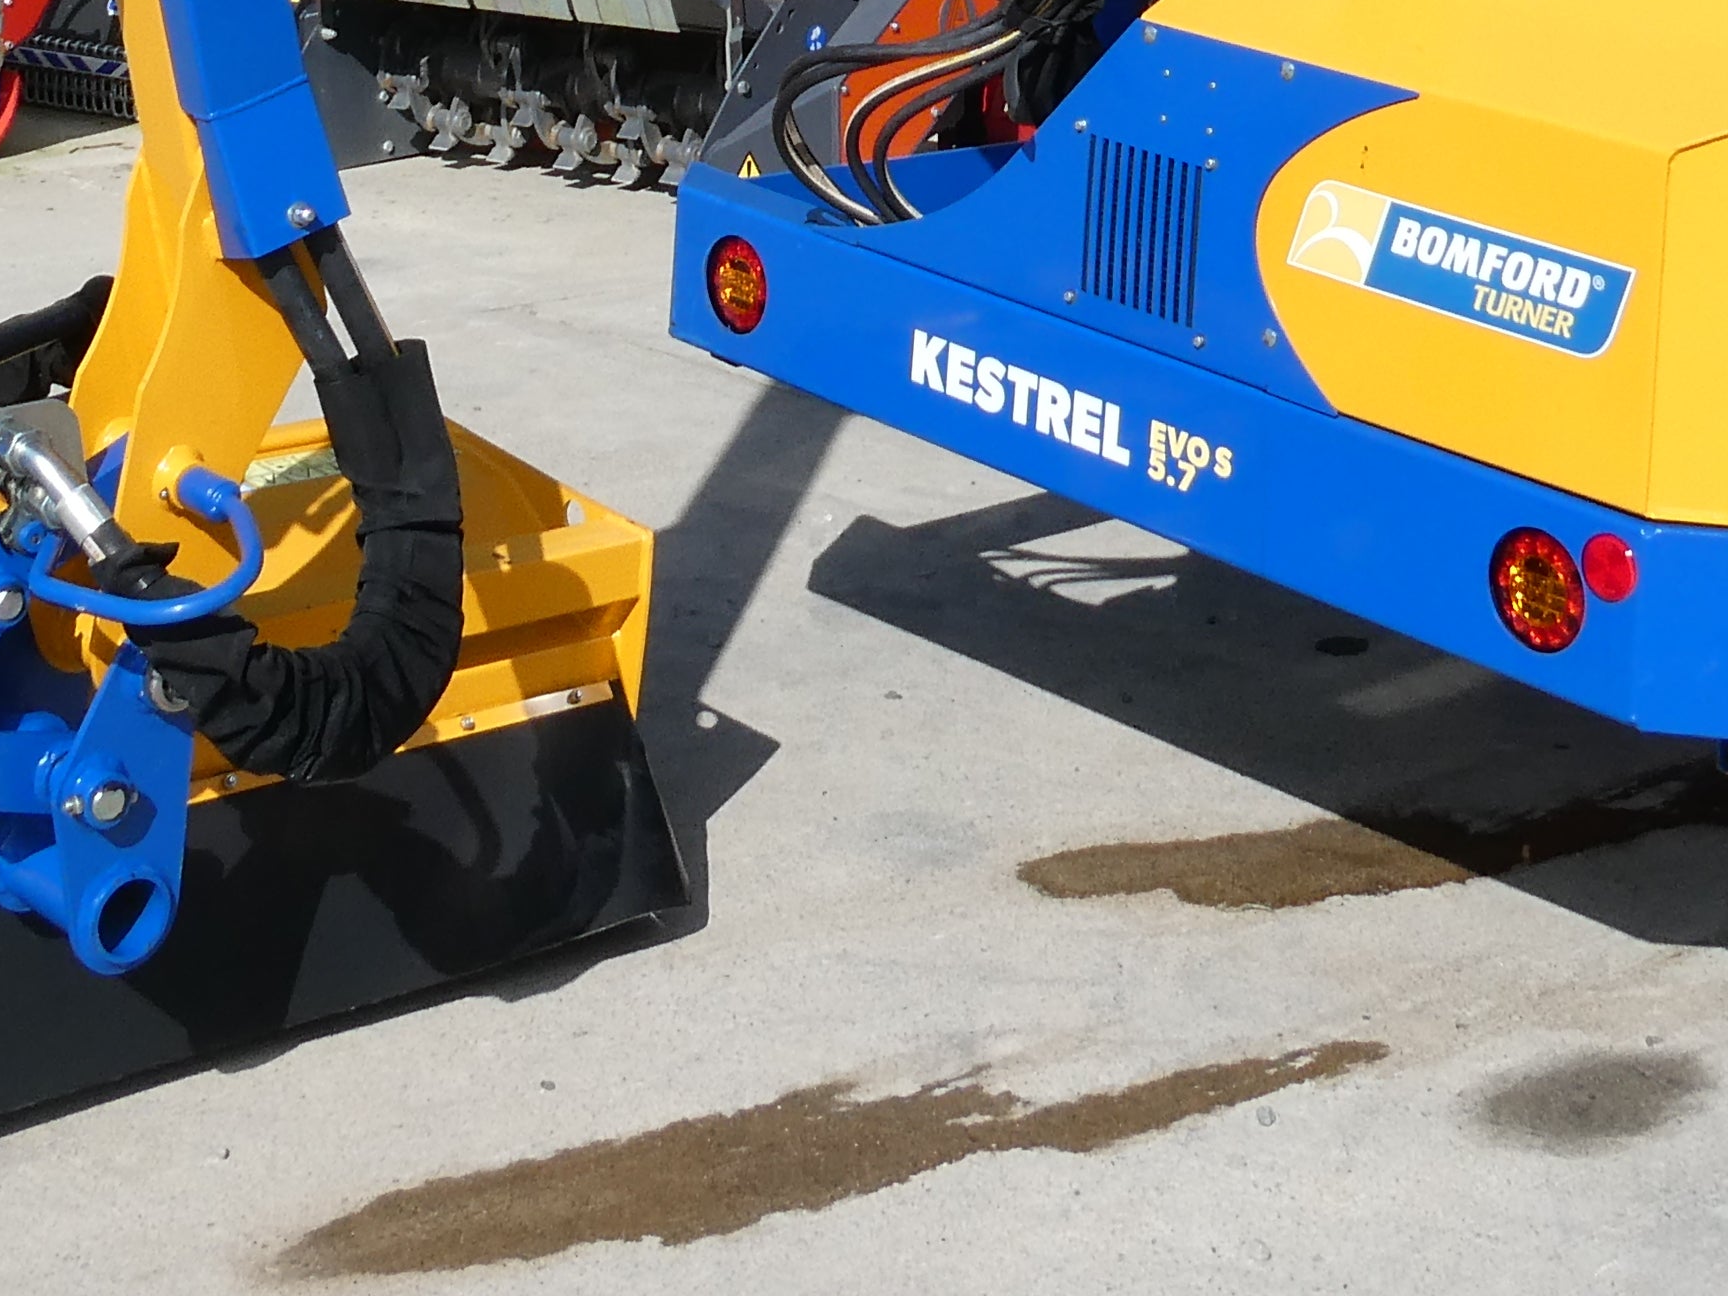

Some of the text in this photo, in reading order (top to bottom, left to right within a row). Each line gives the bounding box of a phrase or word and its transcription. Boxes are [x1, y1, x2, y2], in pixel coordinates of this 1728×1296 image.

[1391, 216, 1590, 309] BOMFORD
[1473, 284, 1574, 338] TURNER
[911, 329, 1130, 466] KESTREL
[1150, 418, 1210, 469] EVO
[1148, 456, 1195, 492] 5.7
